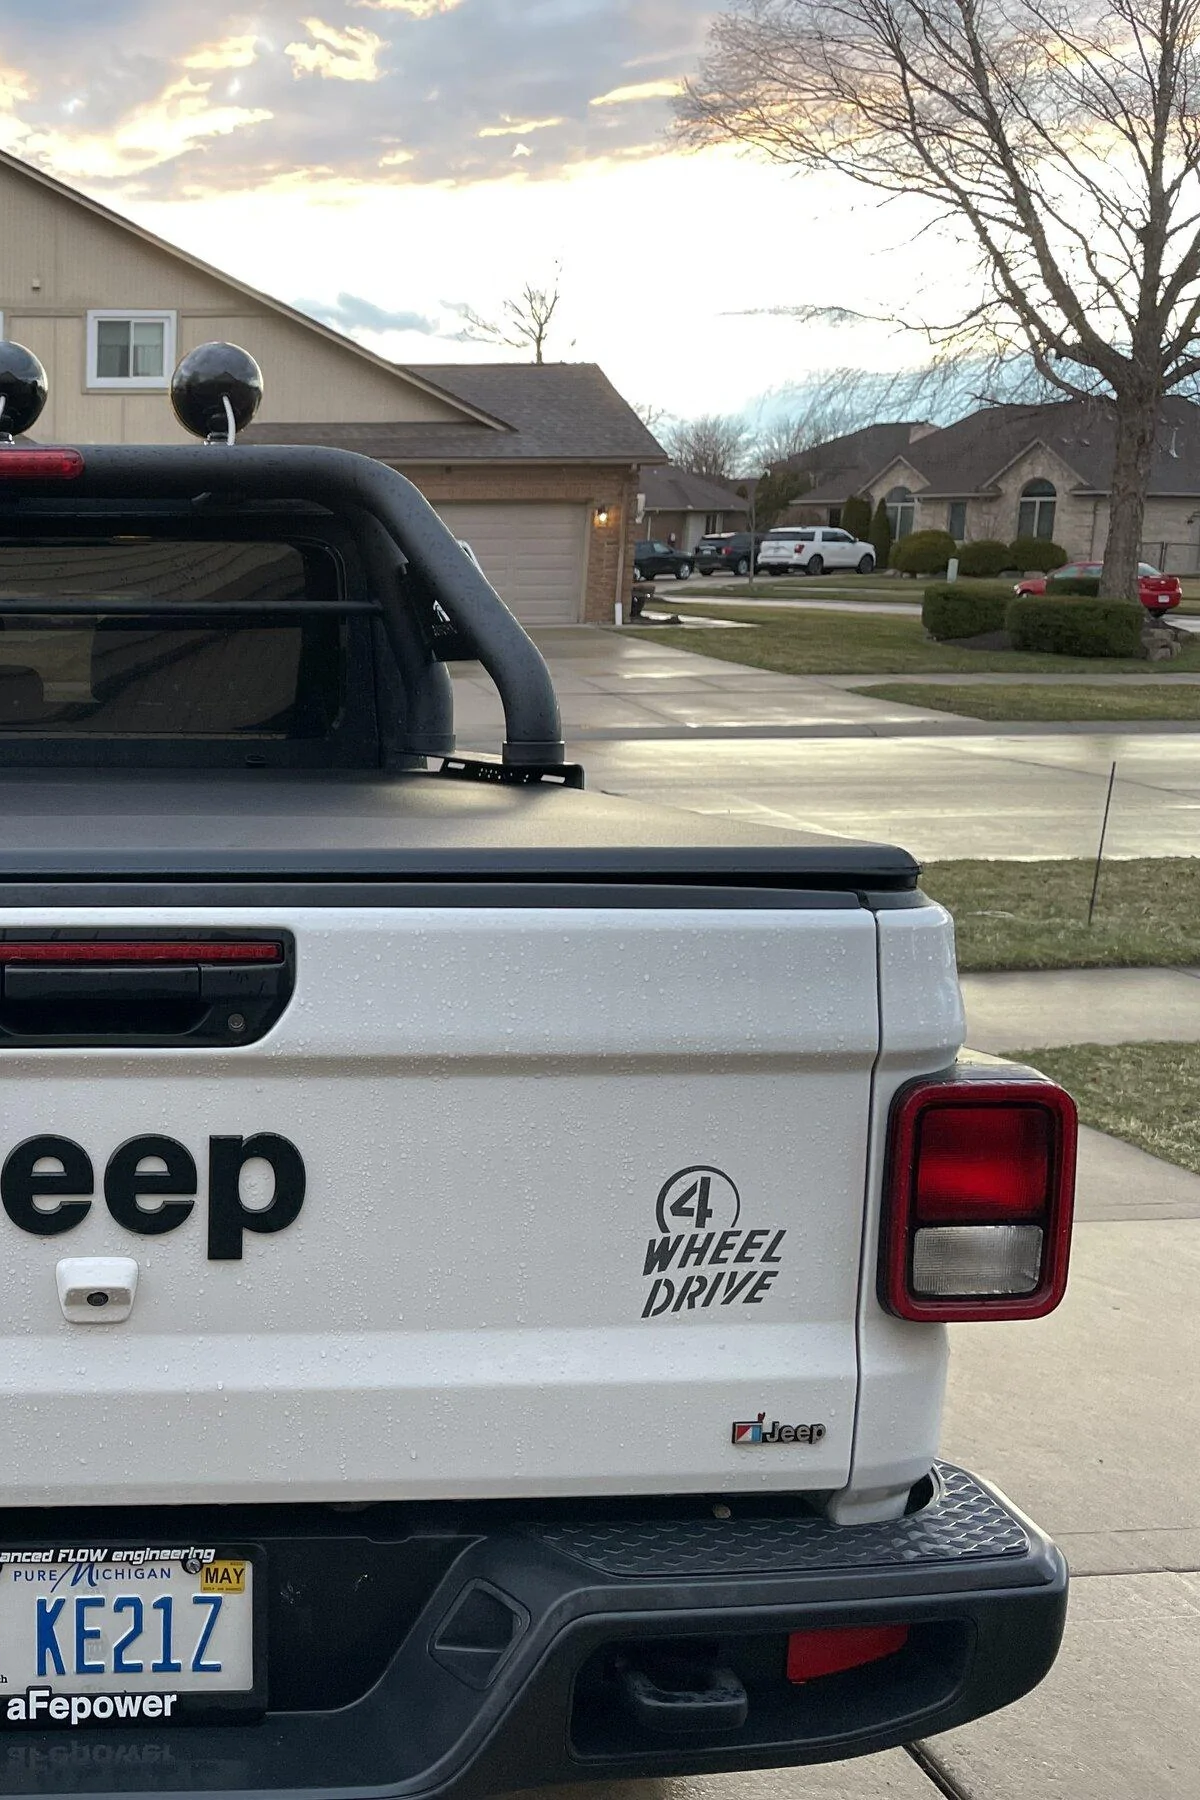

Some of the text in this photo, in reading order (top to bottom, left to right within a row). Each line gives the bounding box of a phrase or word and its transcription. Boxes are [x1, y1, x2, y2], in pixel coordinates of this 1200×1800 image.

[669, 1176, 713, 1229] 4
[642, 1229, 787, 1277] WHEEL
[640, 1270, 780, 1319] DRIVE
[763, 1420, 827, 1445] Jeep
[57, 1548, 108, 1563] FLOW
[112, 1546, 216, 1566] engineering
[13, 1562, 172, 1593] PURE MICHIGAN
[205, 1567, 245, 1584] MAY
[35, 1594, 223, 1677] KE21Z
[6, 1689, 178, 1726] aFepower
